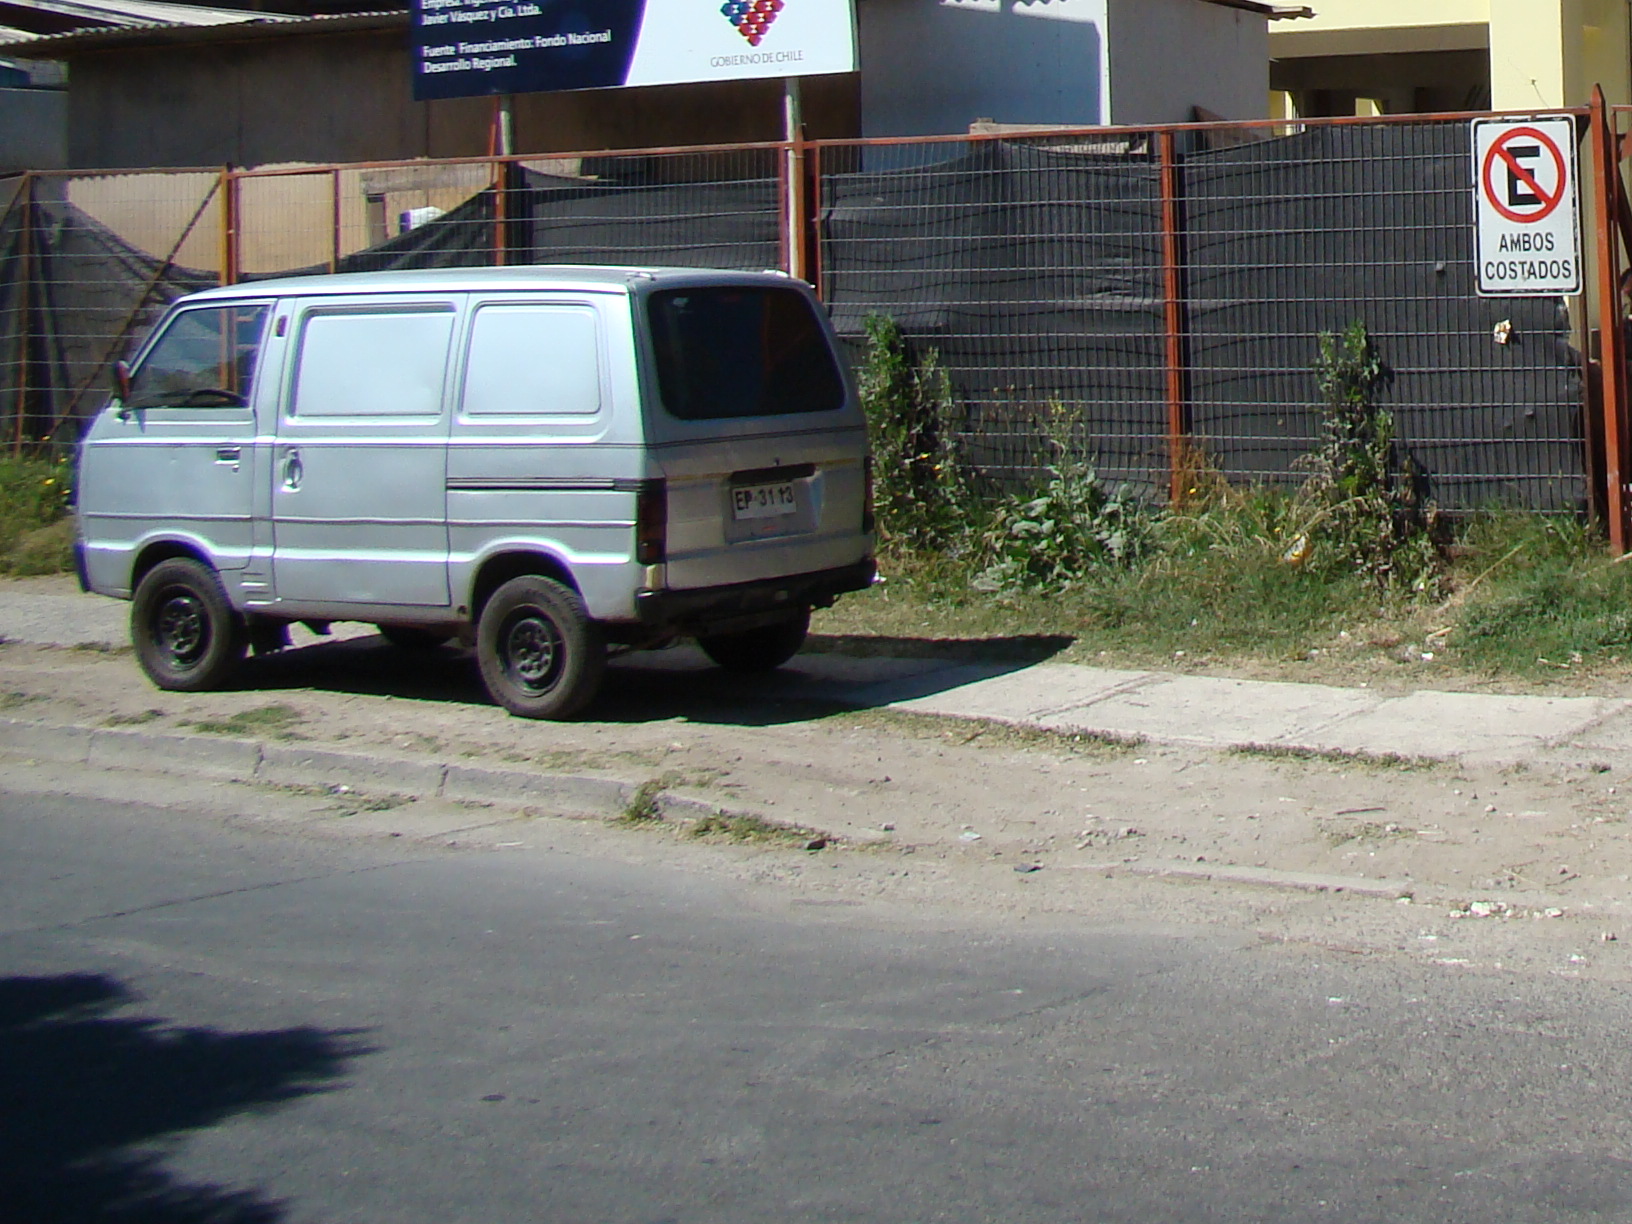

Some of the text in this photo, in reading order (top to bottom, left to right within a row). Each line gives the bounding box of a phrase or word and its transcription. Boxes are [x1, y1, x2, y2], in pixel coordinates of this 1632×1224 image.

[422, 11, 448, 25] Javier
[449, 8, 488, 24] Vásquez
[490, 9, 497, 21] y
[517, 4, 542, 16] Ltda.
[423, 29, 611, 58] Fuente Financiamiento: Fondo Nacional
[423, 55, 517, 74] Desarrollo Regional.
[710, 50, 803, 68] GOBIERNO DE CHILE
[1499, 232, 1555, 252] AMBOS
[1485, 260, 1572, 280] COSTADOS
